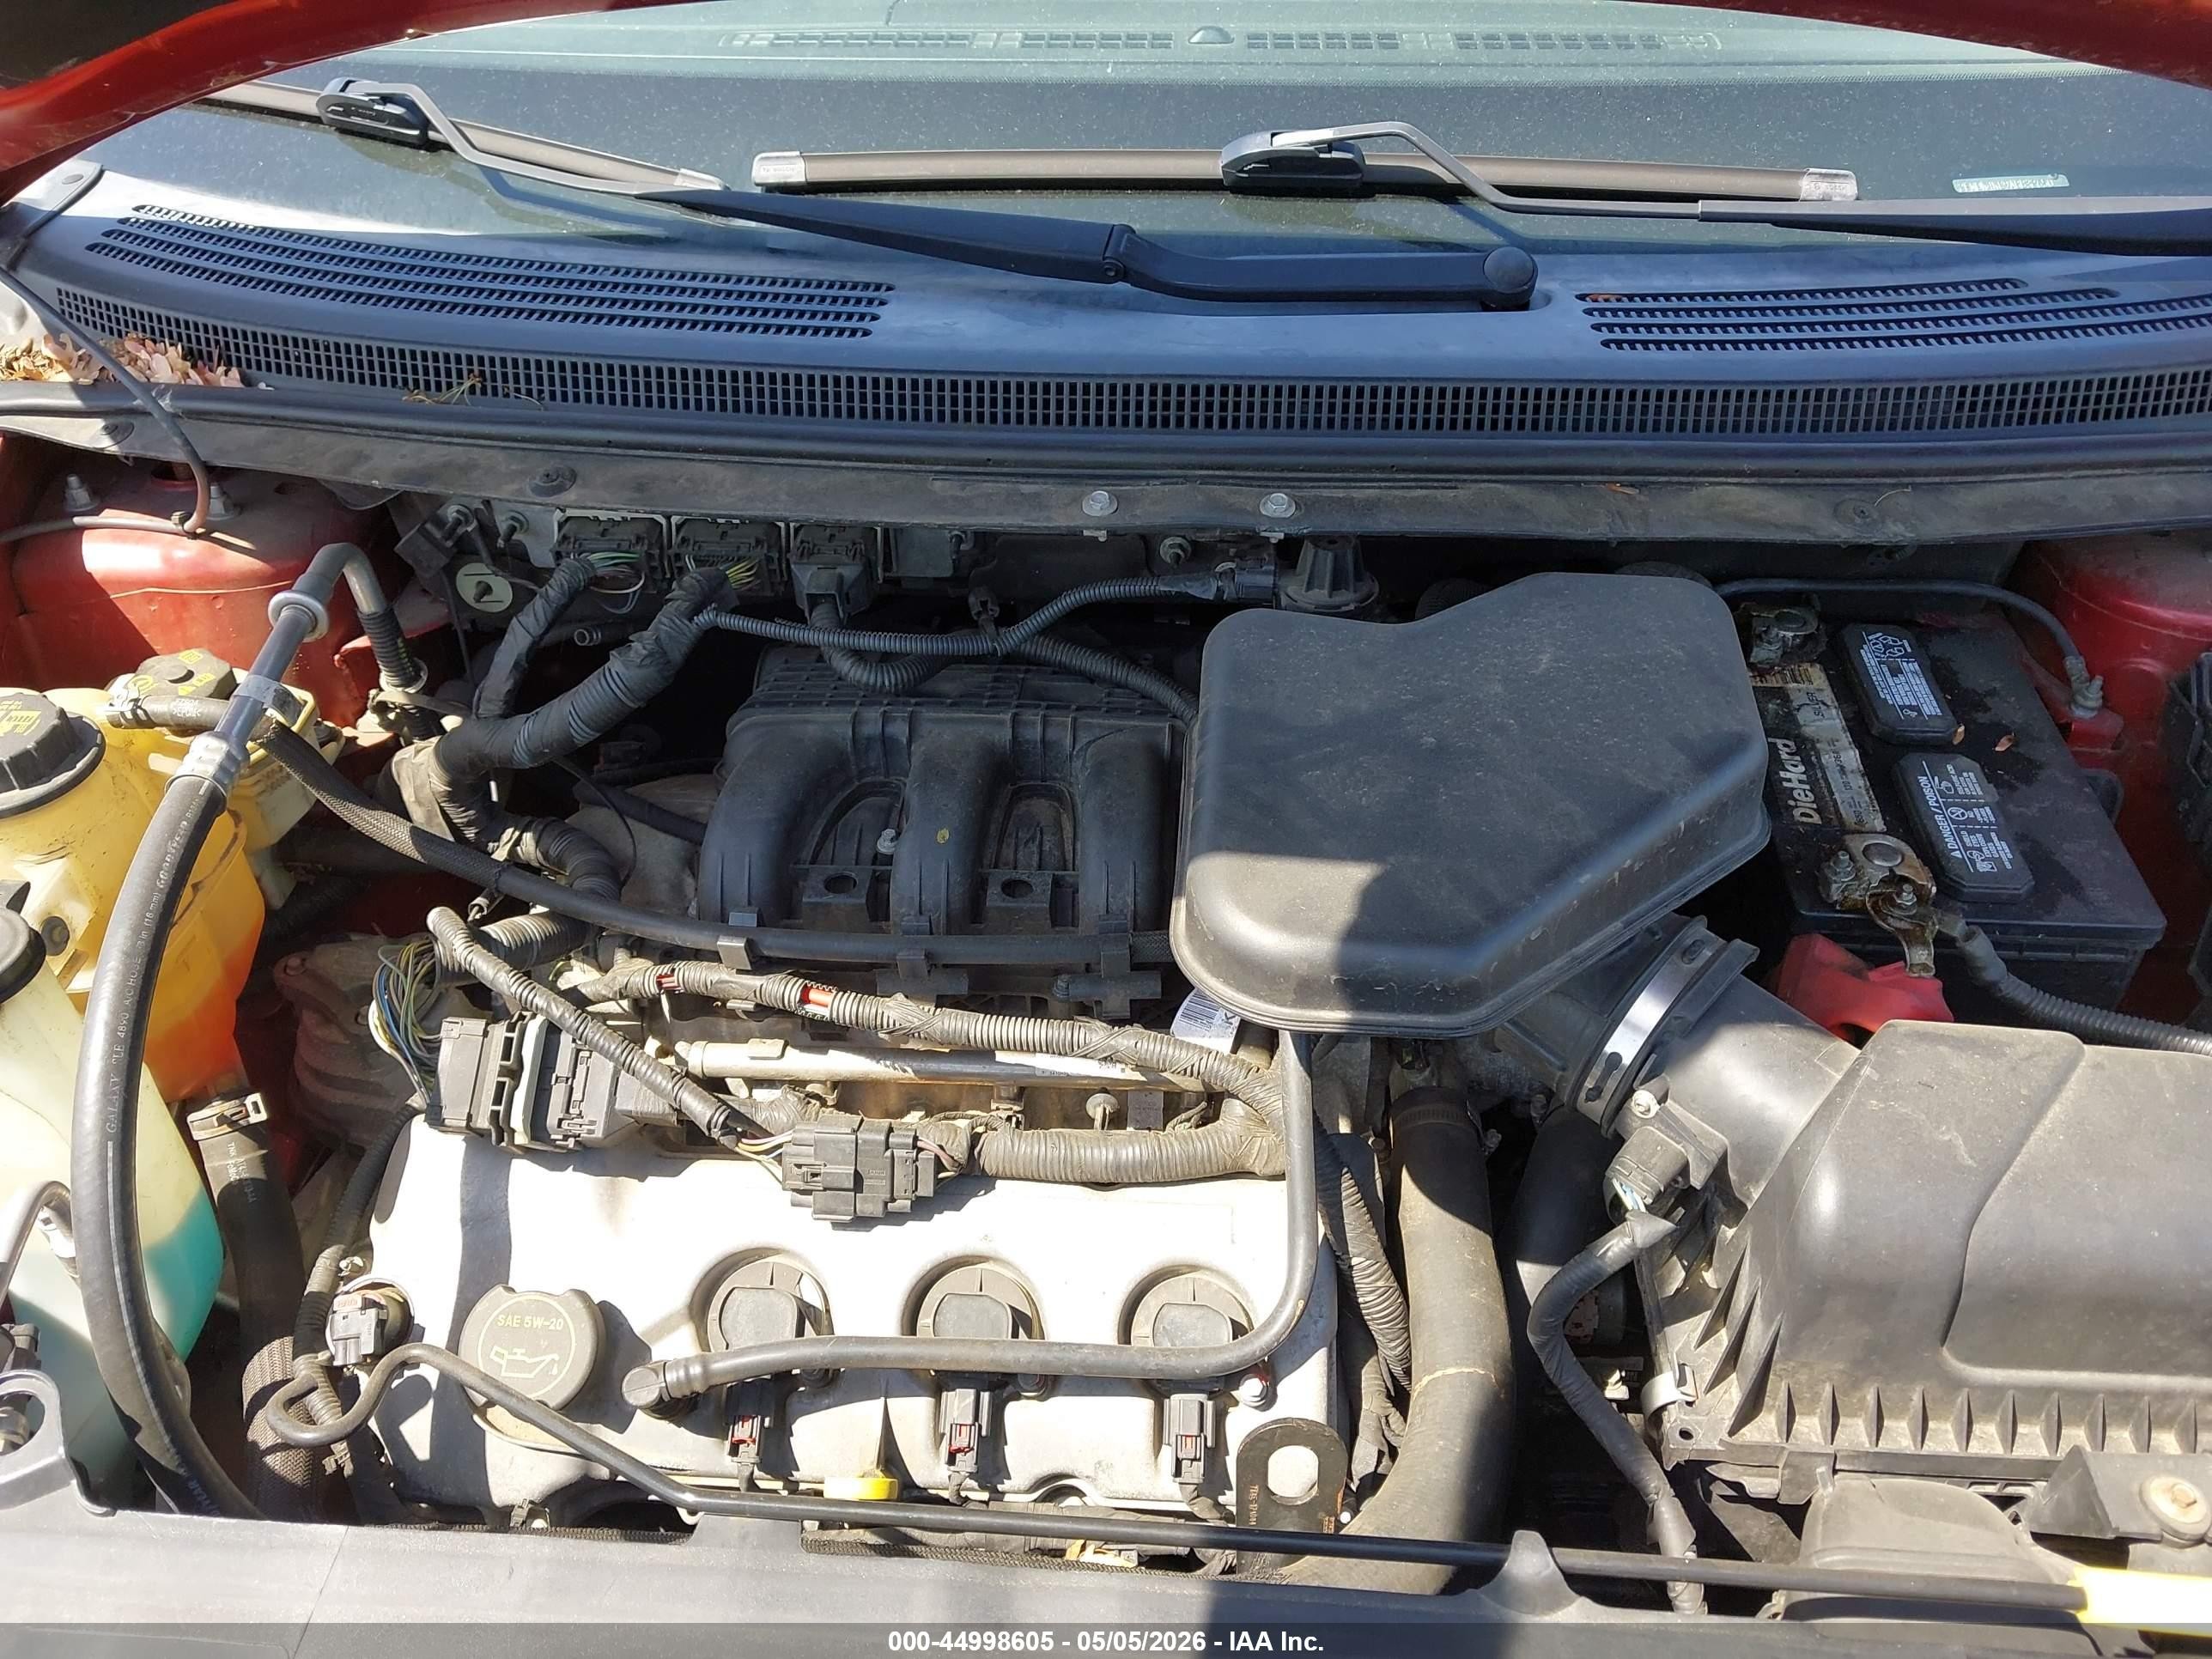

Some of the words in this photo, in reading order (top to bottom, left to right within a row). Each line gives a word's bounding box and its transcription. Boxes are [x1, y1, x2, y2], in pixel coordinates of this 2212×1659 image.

[1767, 737, 1822, 824] DieHard
[1917, 775, 1940, 807] POISON
[1935, 814, 1959, 849] DANGER
[106, 1073, 120, 1133] GALAXY
[127, 957, 142, 986] HOSE
[497, 1313, 521, 1328] SAE
[523, 1316, 564, 1330] 5W-20
